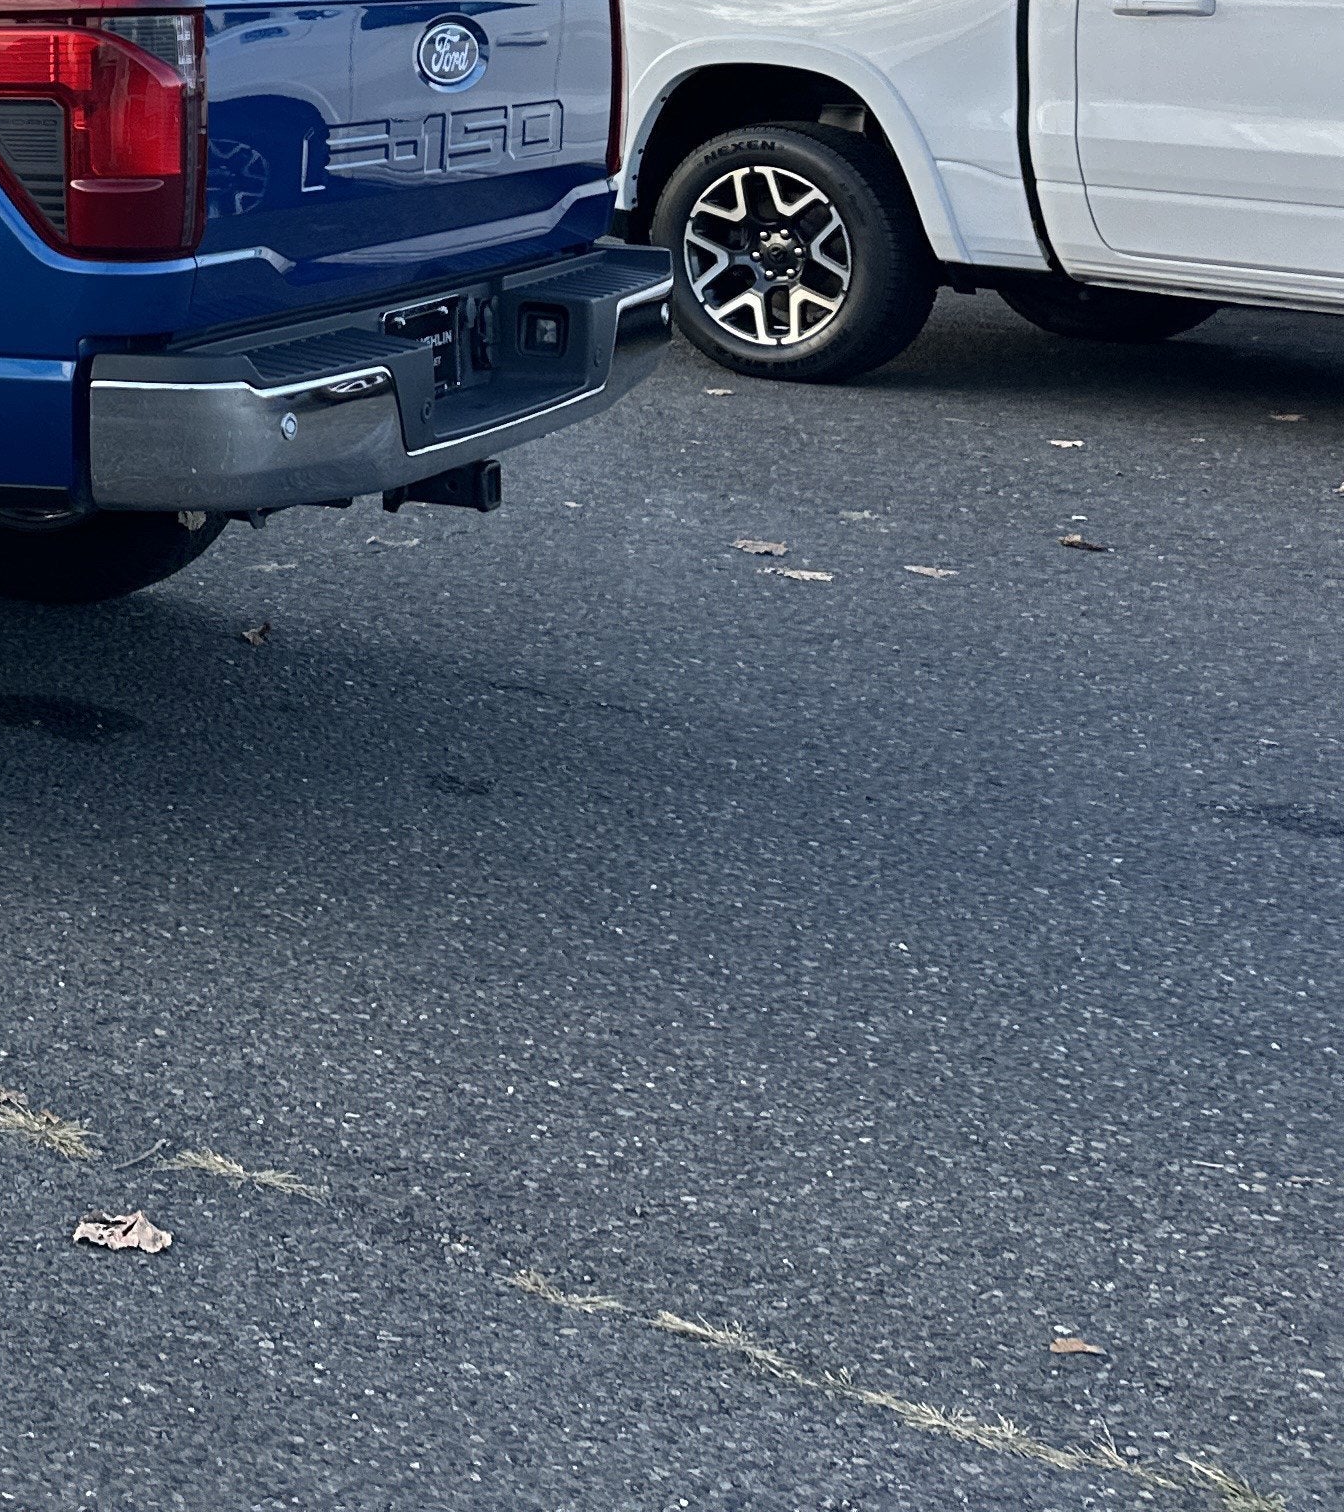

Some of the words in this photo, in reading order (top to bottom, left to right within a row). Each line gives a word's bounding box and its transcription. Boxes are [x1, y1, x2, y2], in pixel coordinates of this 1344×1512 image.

[431, 29, 470, 73] Ford
[301, 99, 564, 192] F-150
[703, 139, 776, 165] NEXEN
